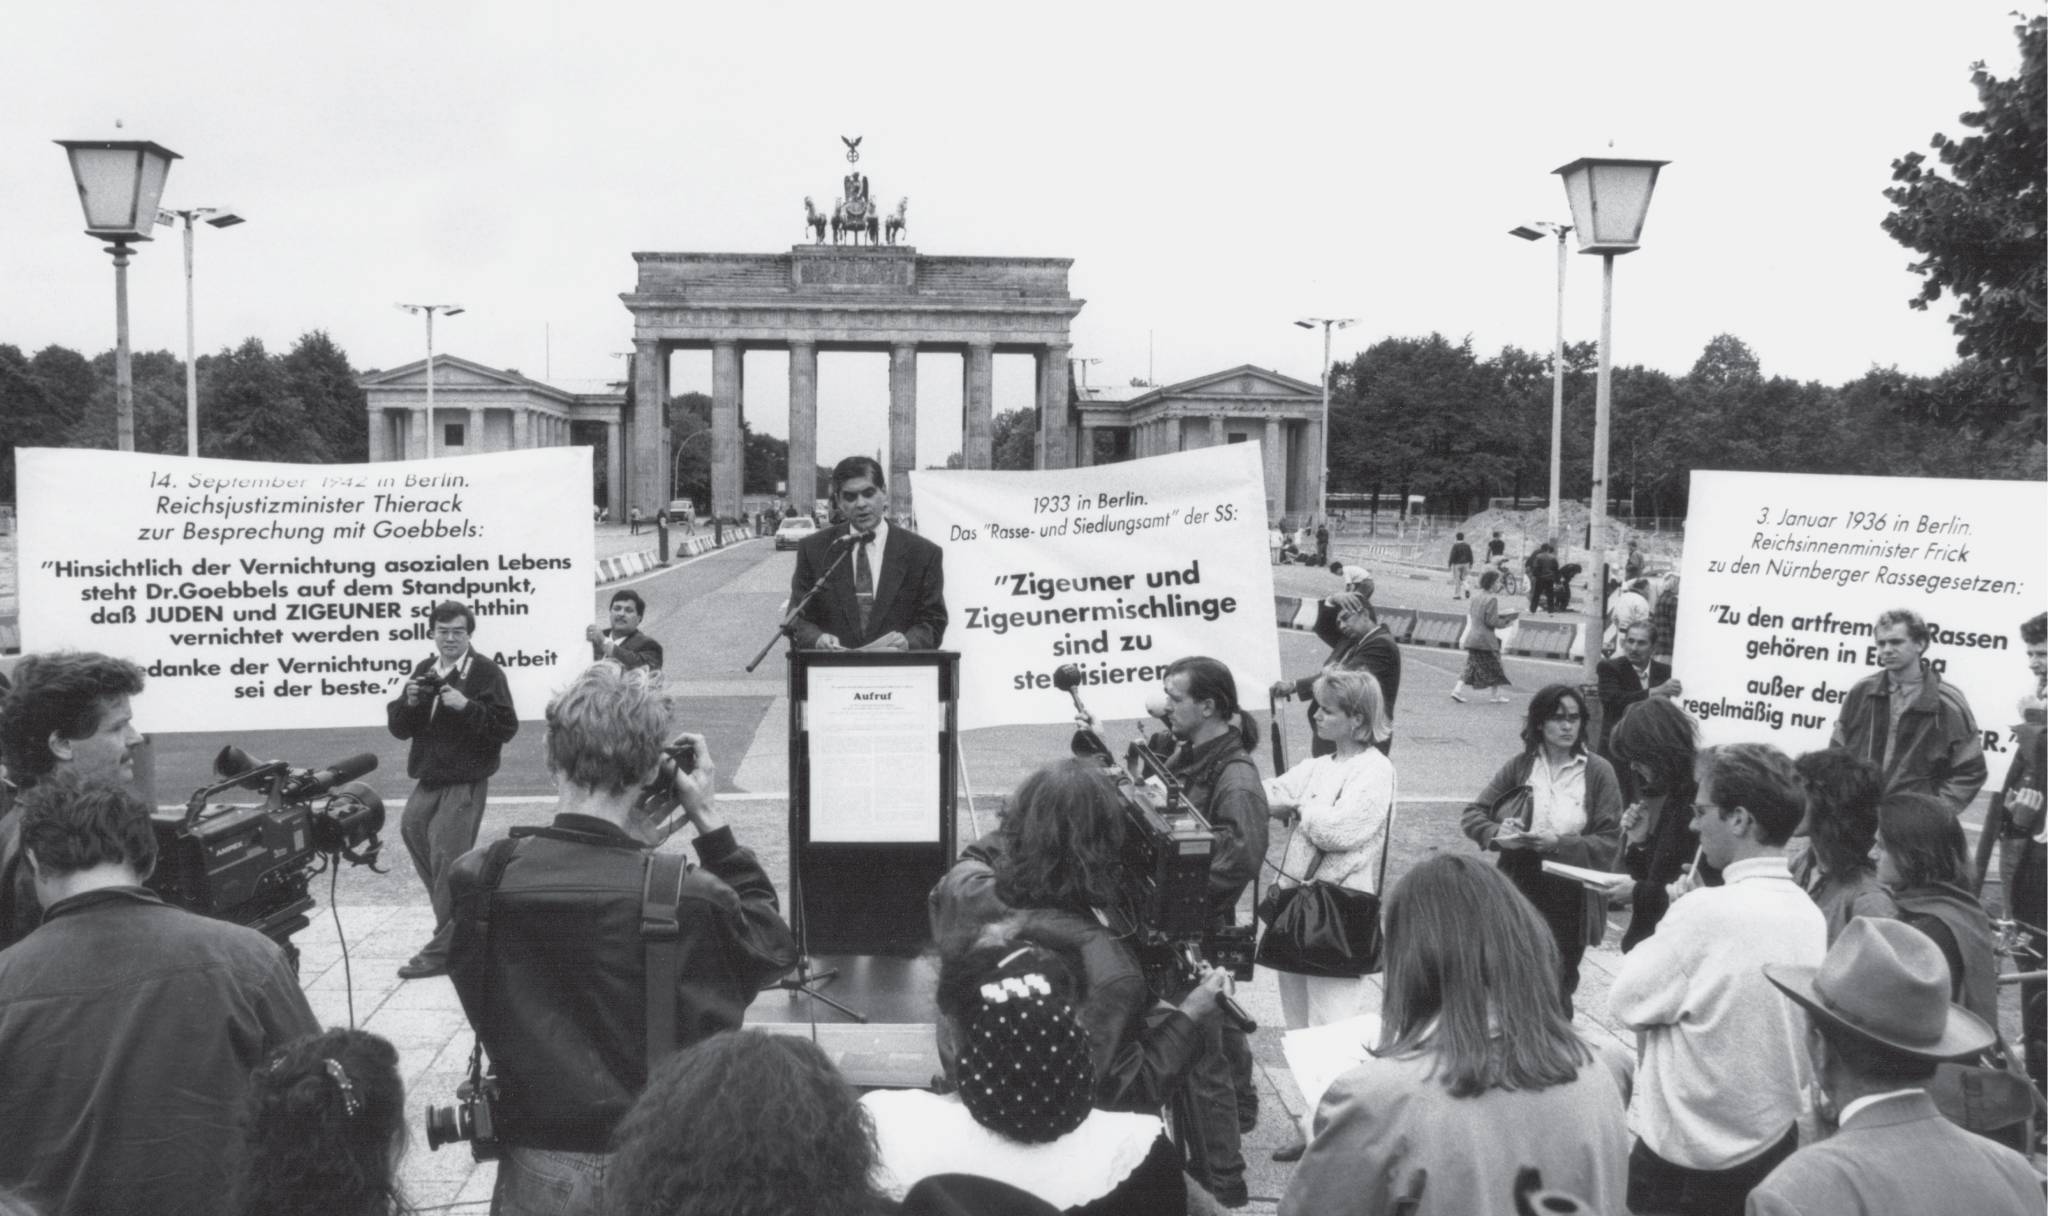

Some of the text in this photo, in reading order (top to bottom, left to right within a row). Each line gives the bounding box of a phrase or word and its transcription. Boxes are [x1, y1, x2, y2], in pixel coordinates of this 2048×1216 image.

[151, 472, 176, 488] 14.
[378, 478, 395, 487] in
[405, 474, 469, 487] Berlin.
[157, 494, 462, 519] Reichsjustizminister Thierack
[1034, 491, 1147, 513] 1933 in Berlin.
[138, 519, 483, 545] zur Besprechung mit Goebbels:
[950, 525, 976, 541] Das
[1040, 517, 1068, 537] und
[1184, 507, 1209, 525] der
[1215, 504, 1237, 522] SS:
[1757, 507, 1972, 536] 3. Januar 1936 in Berlin.
[1752, 532, 1969, 562] Reichsinnenminister Frick
[192, 558, 231, 575] der
[240, 556, 375, 578] Vernichtung
[385, 554, 489, 572] asozialen
[499, 553, 571, 570] Lebens
[1147, 560, 1200, 588] und
[1708, 555, 2023, 594] zu den Nürnberger Rassegesetzen:
[82, 576, 535, 601] steht Dr.Goebbels auf dem Standpunkt,
[91, 605, 136, 624] daß
[146, 606, 223, 623] JUDEN
[234, 603, 276, 622] und
[286, 602, 401, 620] ZIGEUNER
[965, 593, 1237, 635] Zigeunermischlinge
[170, 627, 283, 645] vernichtet
[292, 625, 379, 643] werden
[1747, 606, 1784, 628] den
[1791, 612, 1873, 637] artfrem
[1926, 622, 2008, 650] Rassen
[1053, 630, 1152, 656] sind zu
[1747, 635, 1829, 660] gehören
[1838, 642, 1856, 663] in
[136, 658, 222, 677] edanke
[230, 658, 269, 675] der
[277, 655, 412, 675] Vernichtung
[492, 649, 558, 667] Arbeit
[1013, 662, 1168, 690] steisieren
[235, 680, 264, 698] sei
[274, 679, 312, 697] der
[854, 692, 891, 700] Aufruf
[1747, 675, 1848, 704] außer der
[1682, 696, 1826, 730] regelmäßig nur
